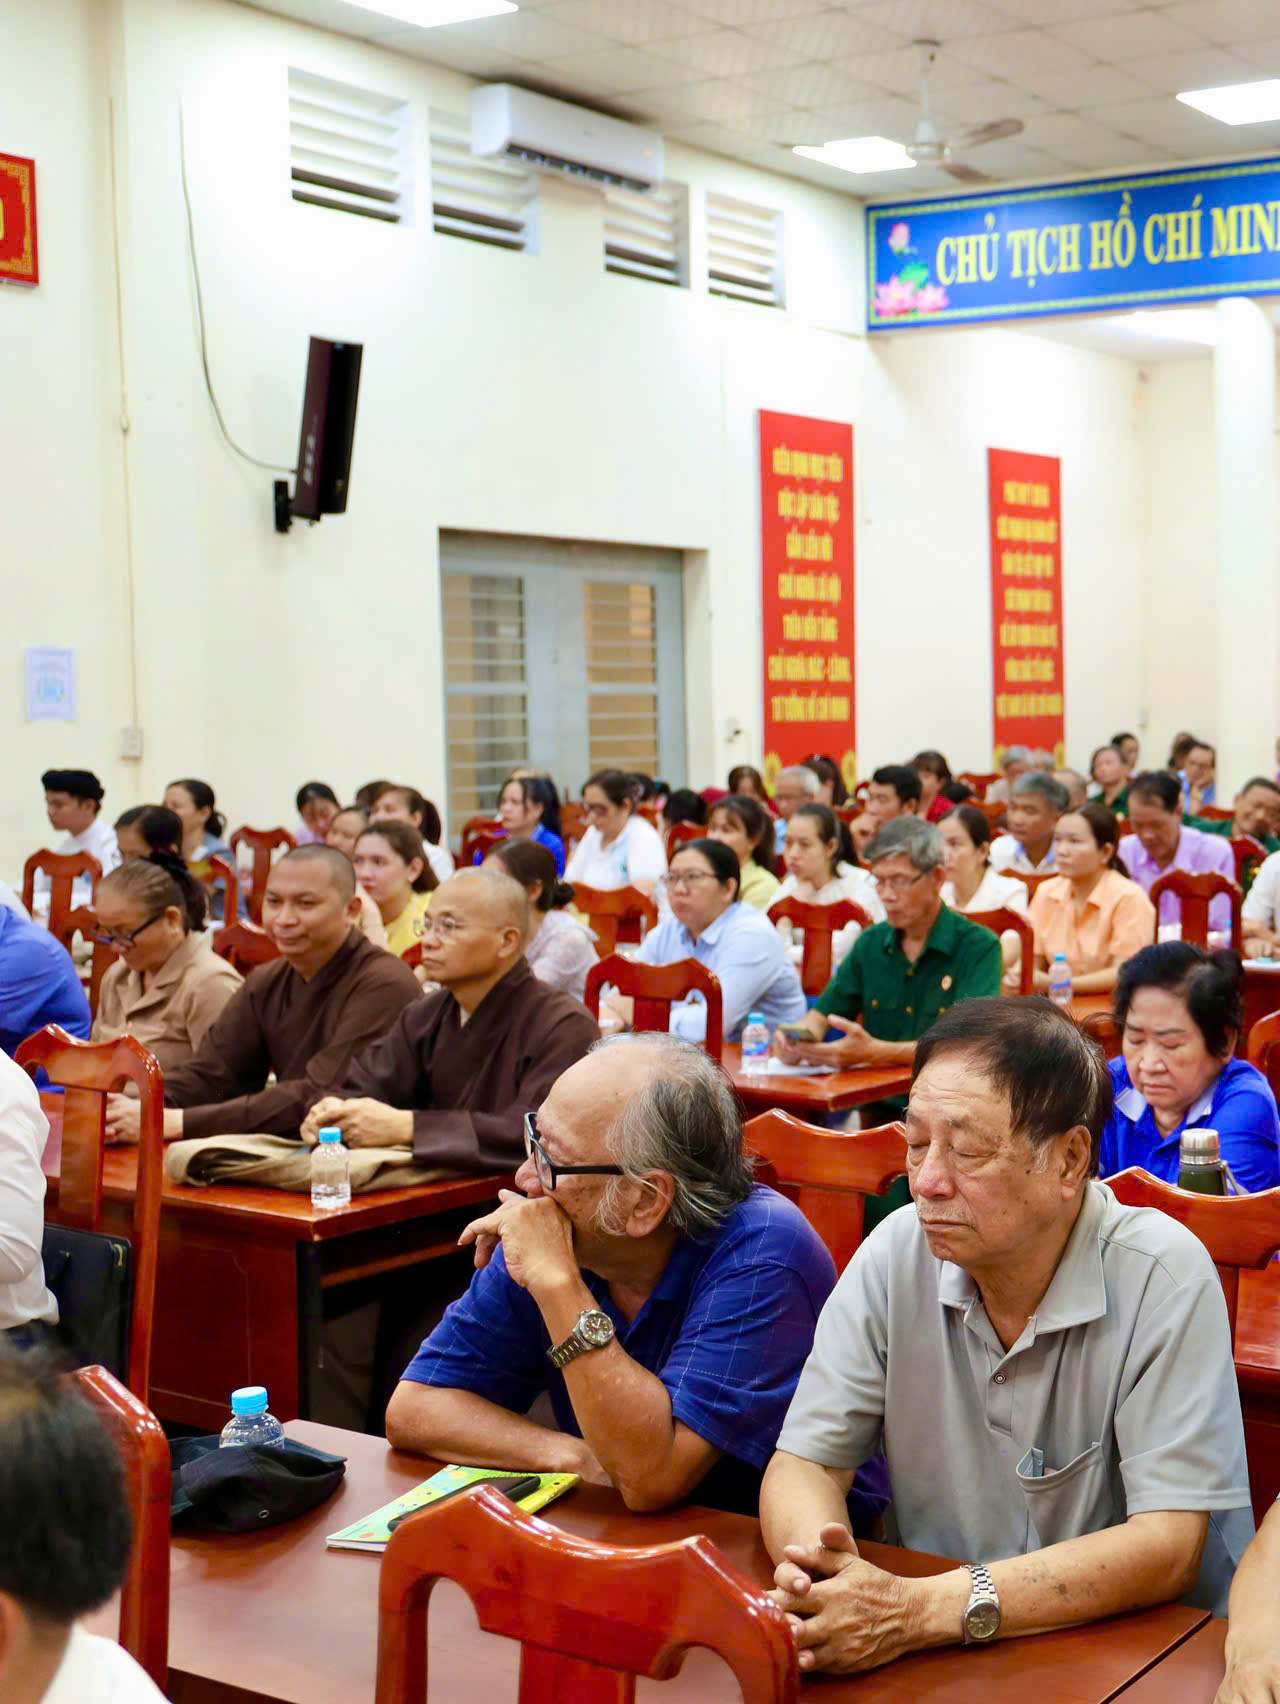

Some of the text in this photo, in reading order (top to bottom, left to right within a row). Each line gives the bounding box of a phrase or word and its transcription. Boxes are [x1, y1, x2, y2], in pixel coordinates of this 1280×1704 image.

[936, 212, 1000, 286] CHỦ
[1007, 223, 1082, 288] TỊCH
[1088, 191, 1137, 270] HỒ
[1143, 193, 1203, 264] CHÍ
